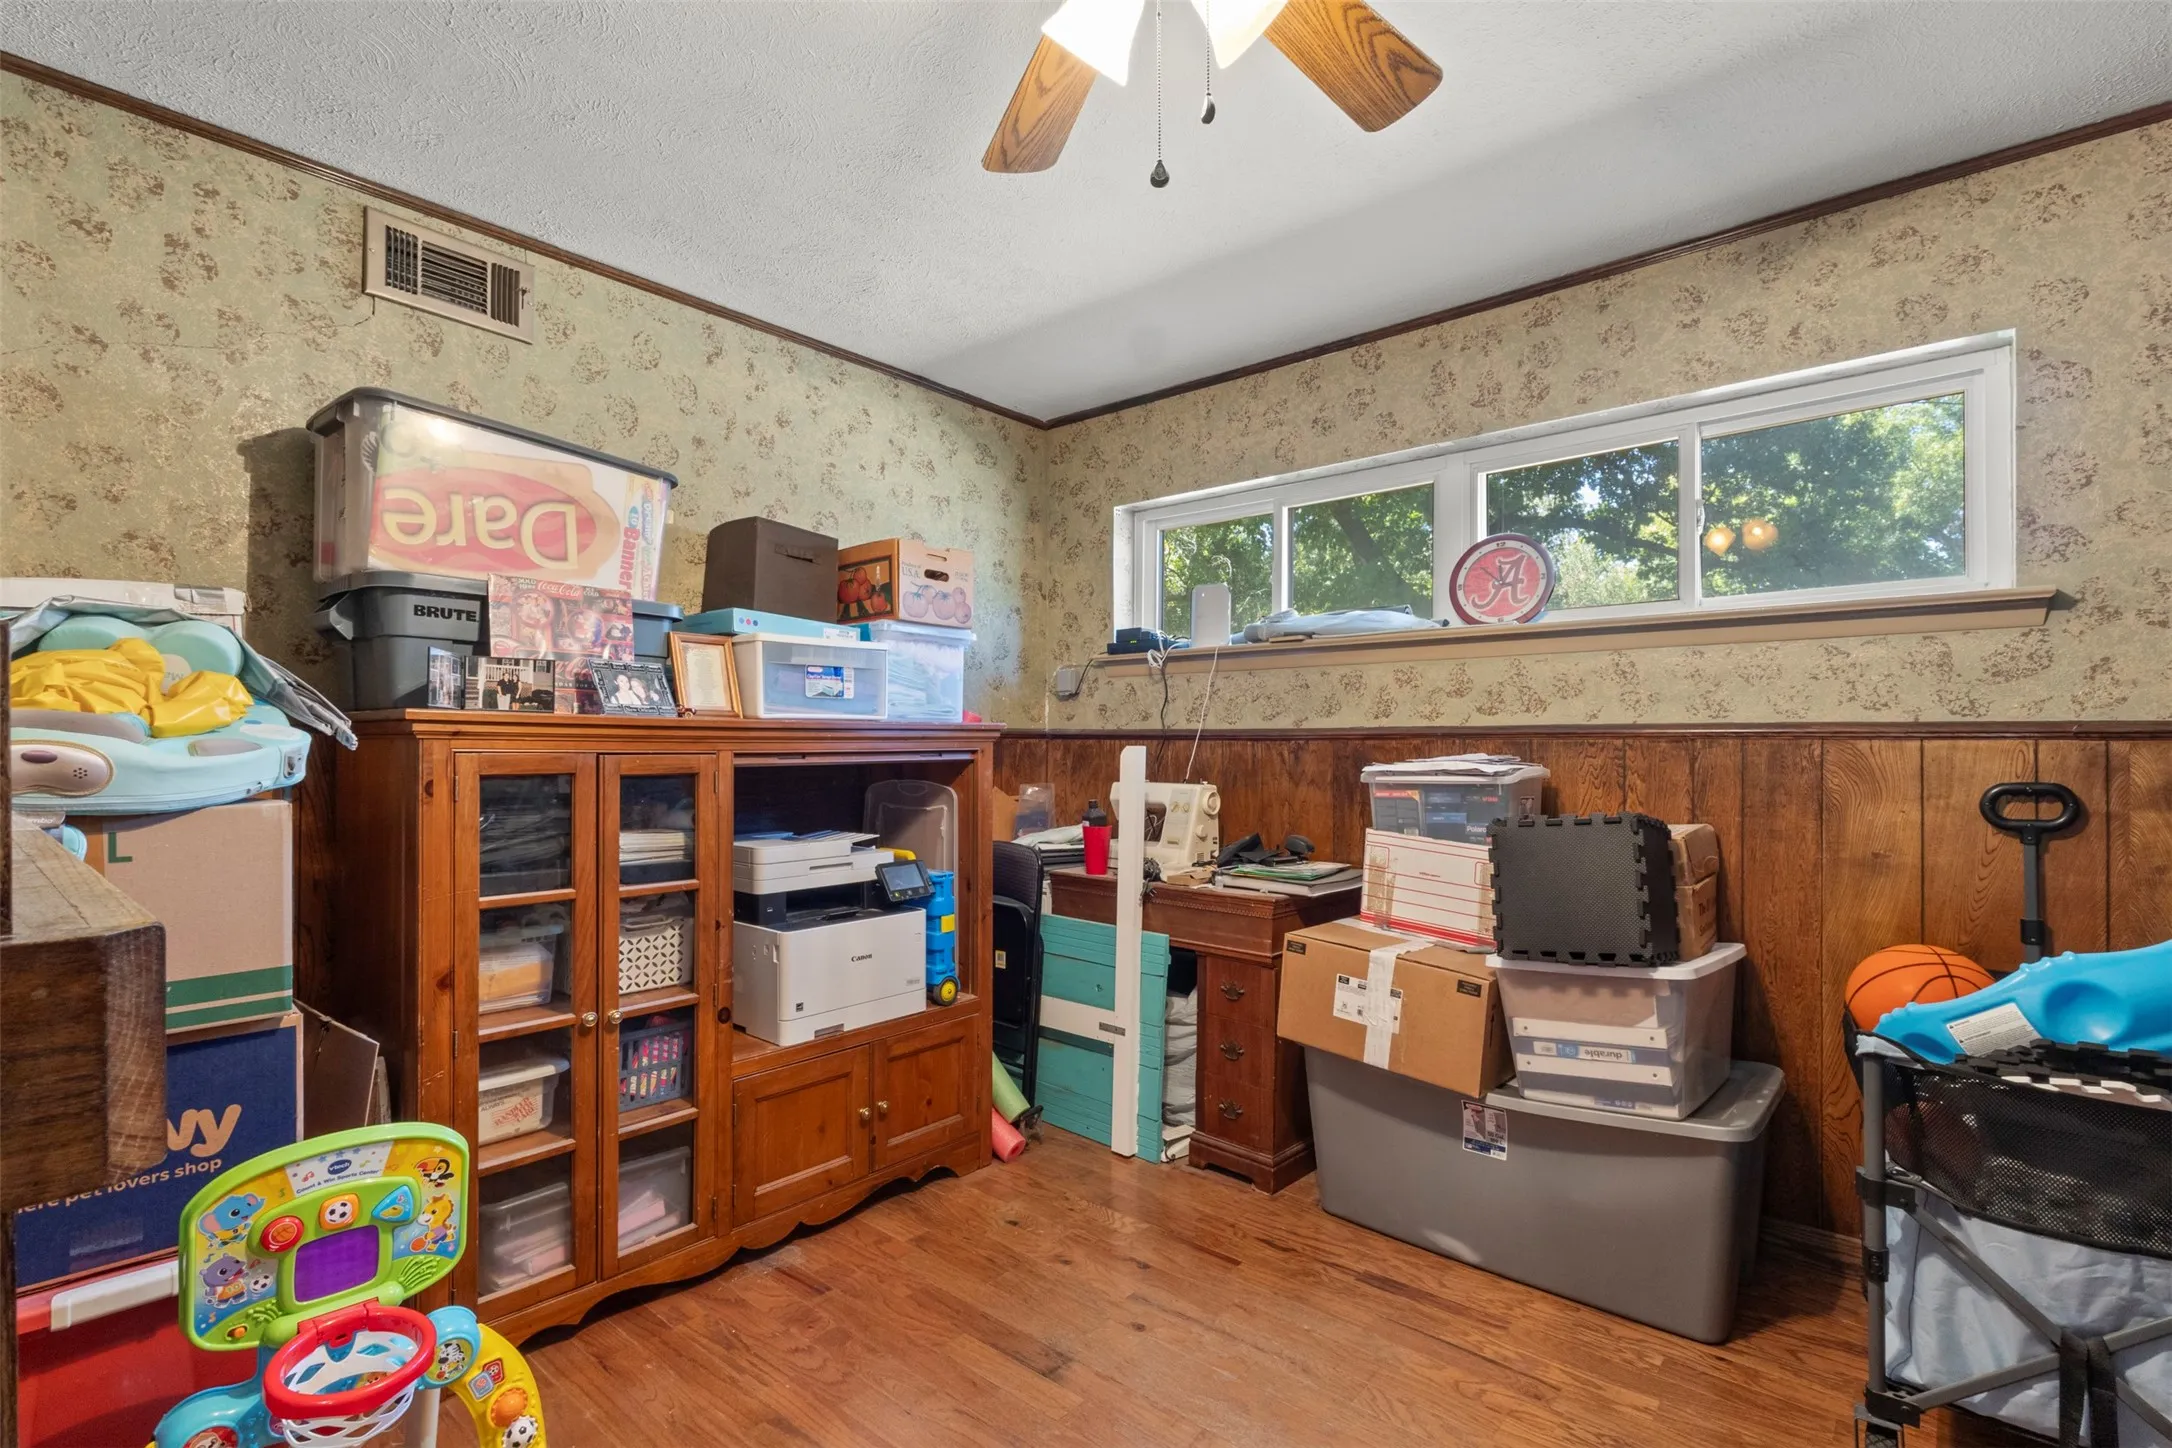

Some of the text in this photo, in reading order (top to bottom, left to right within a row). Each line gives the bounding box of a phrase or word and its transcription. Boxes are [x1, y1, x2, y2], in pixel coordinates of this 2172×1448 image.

[381, 487, 579, 570] Dare
[414, 604, 477, 622] BRUTE
[851, 953, 873, 962] Canon
[1584, 1049, 1623, 1060] durable
[174, 1159, 222, 1178] shop
[337, 1172, 358, 1181] Sports
